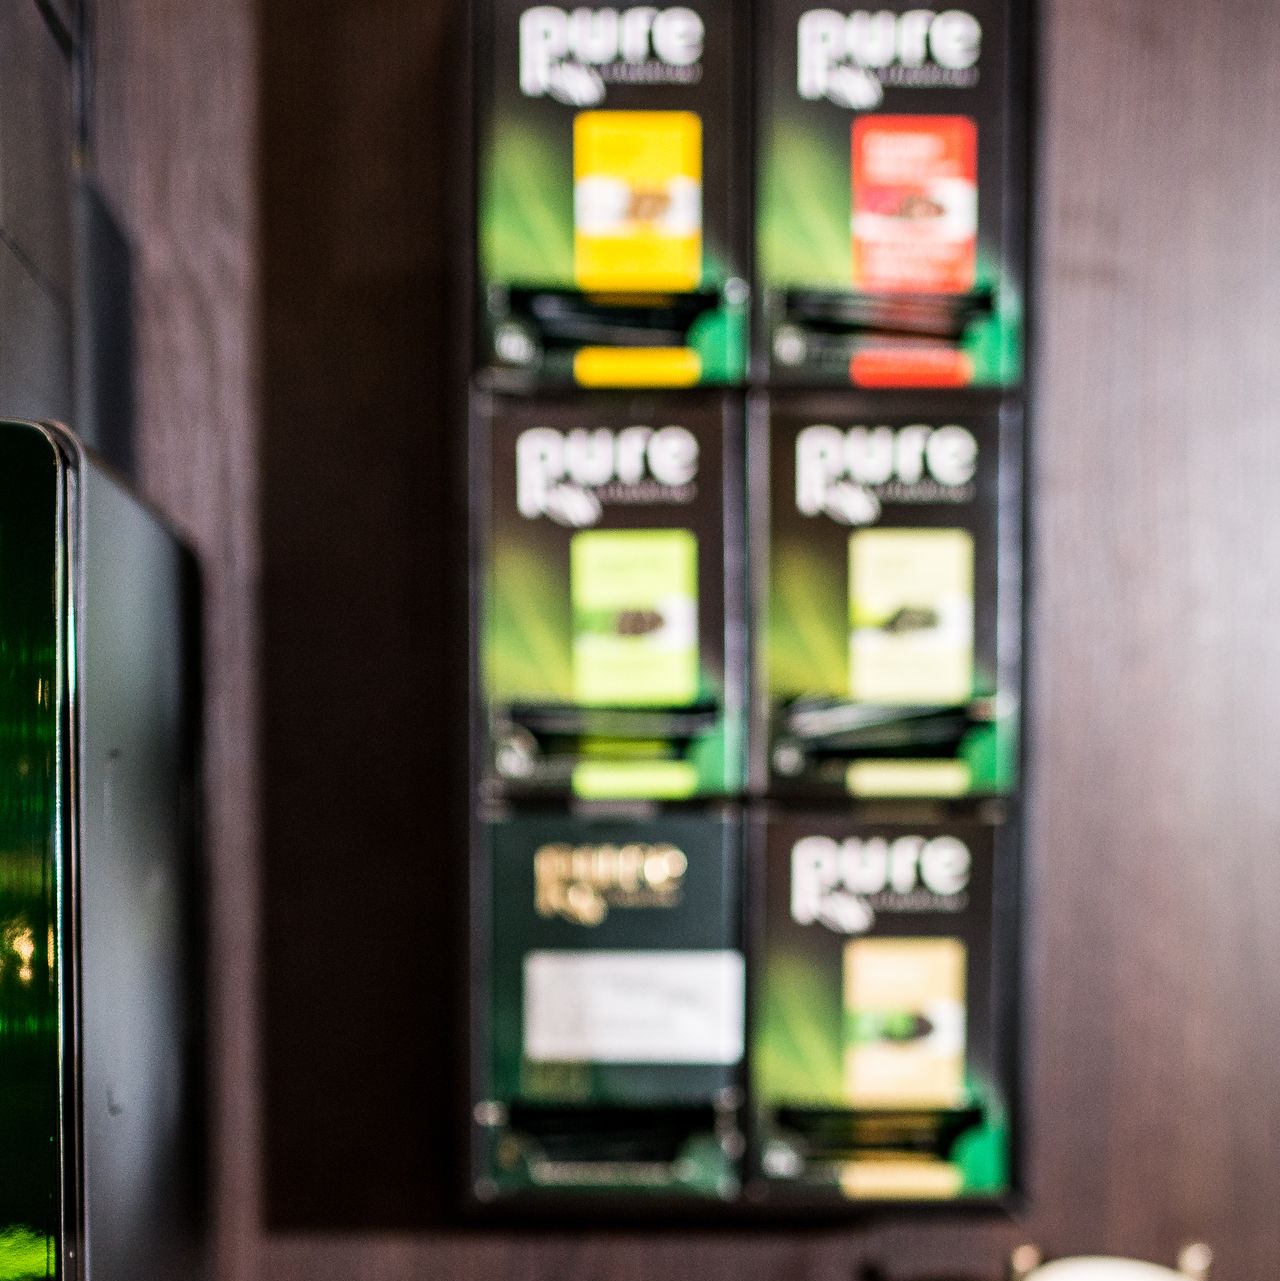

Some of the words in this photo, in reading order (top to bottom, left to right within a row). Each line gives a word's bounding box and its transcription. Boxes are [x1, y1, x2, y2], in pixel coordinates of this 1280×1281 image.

[520, 6, 705, 98] pure
[798, 9, 982, 100] pure
[516, 426, 699, 519] pure
[796, 424, 978, 517] pure
[791, 836, 972, 924] pure
